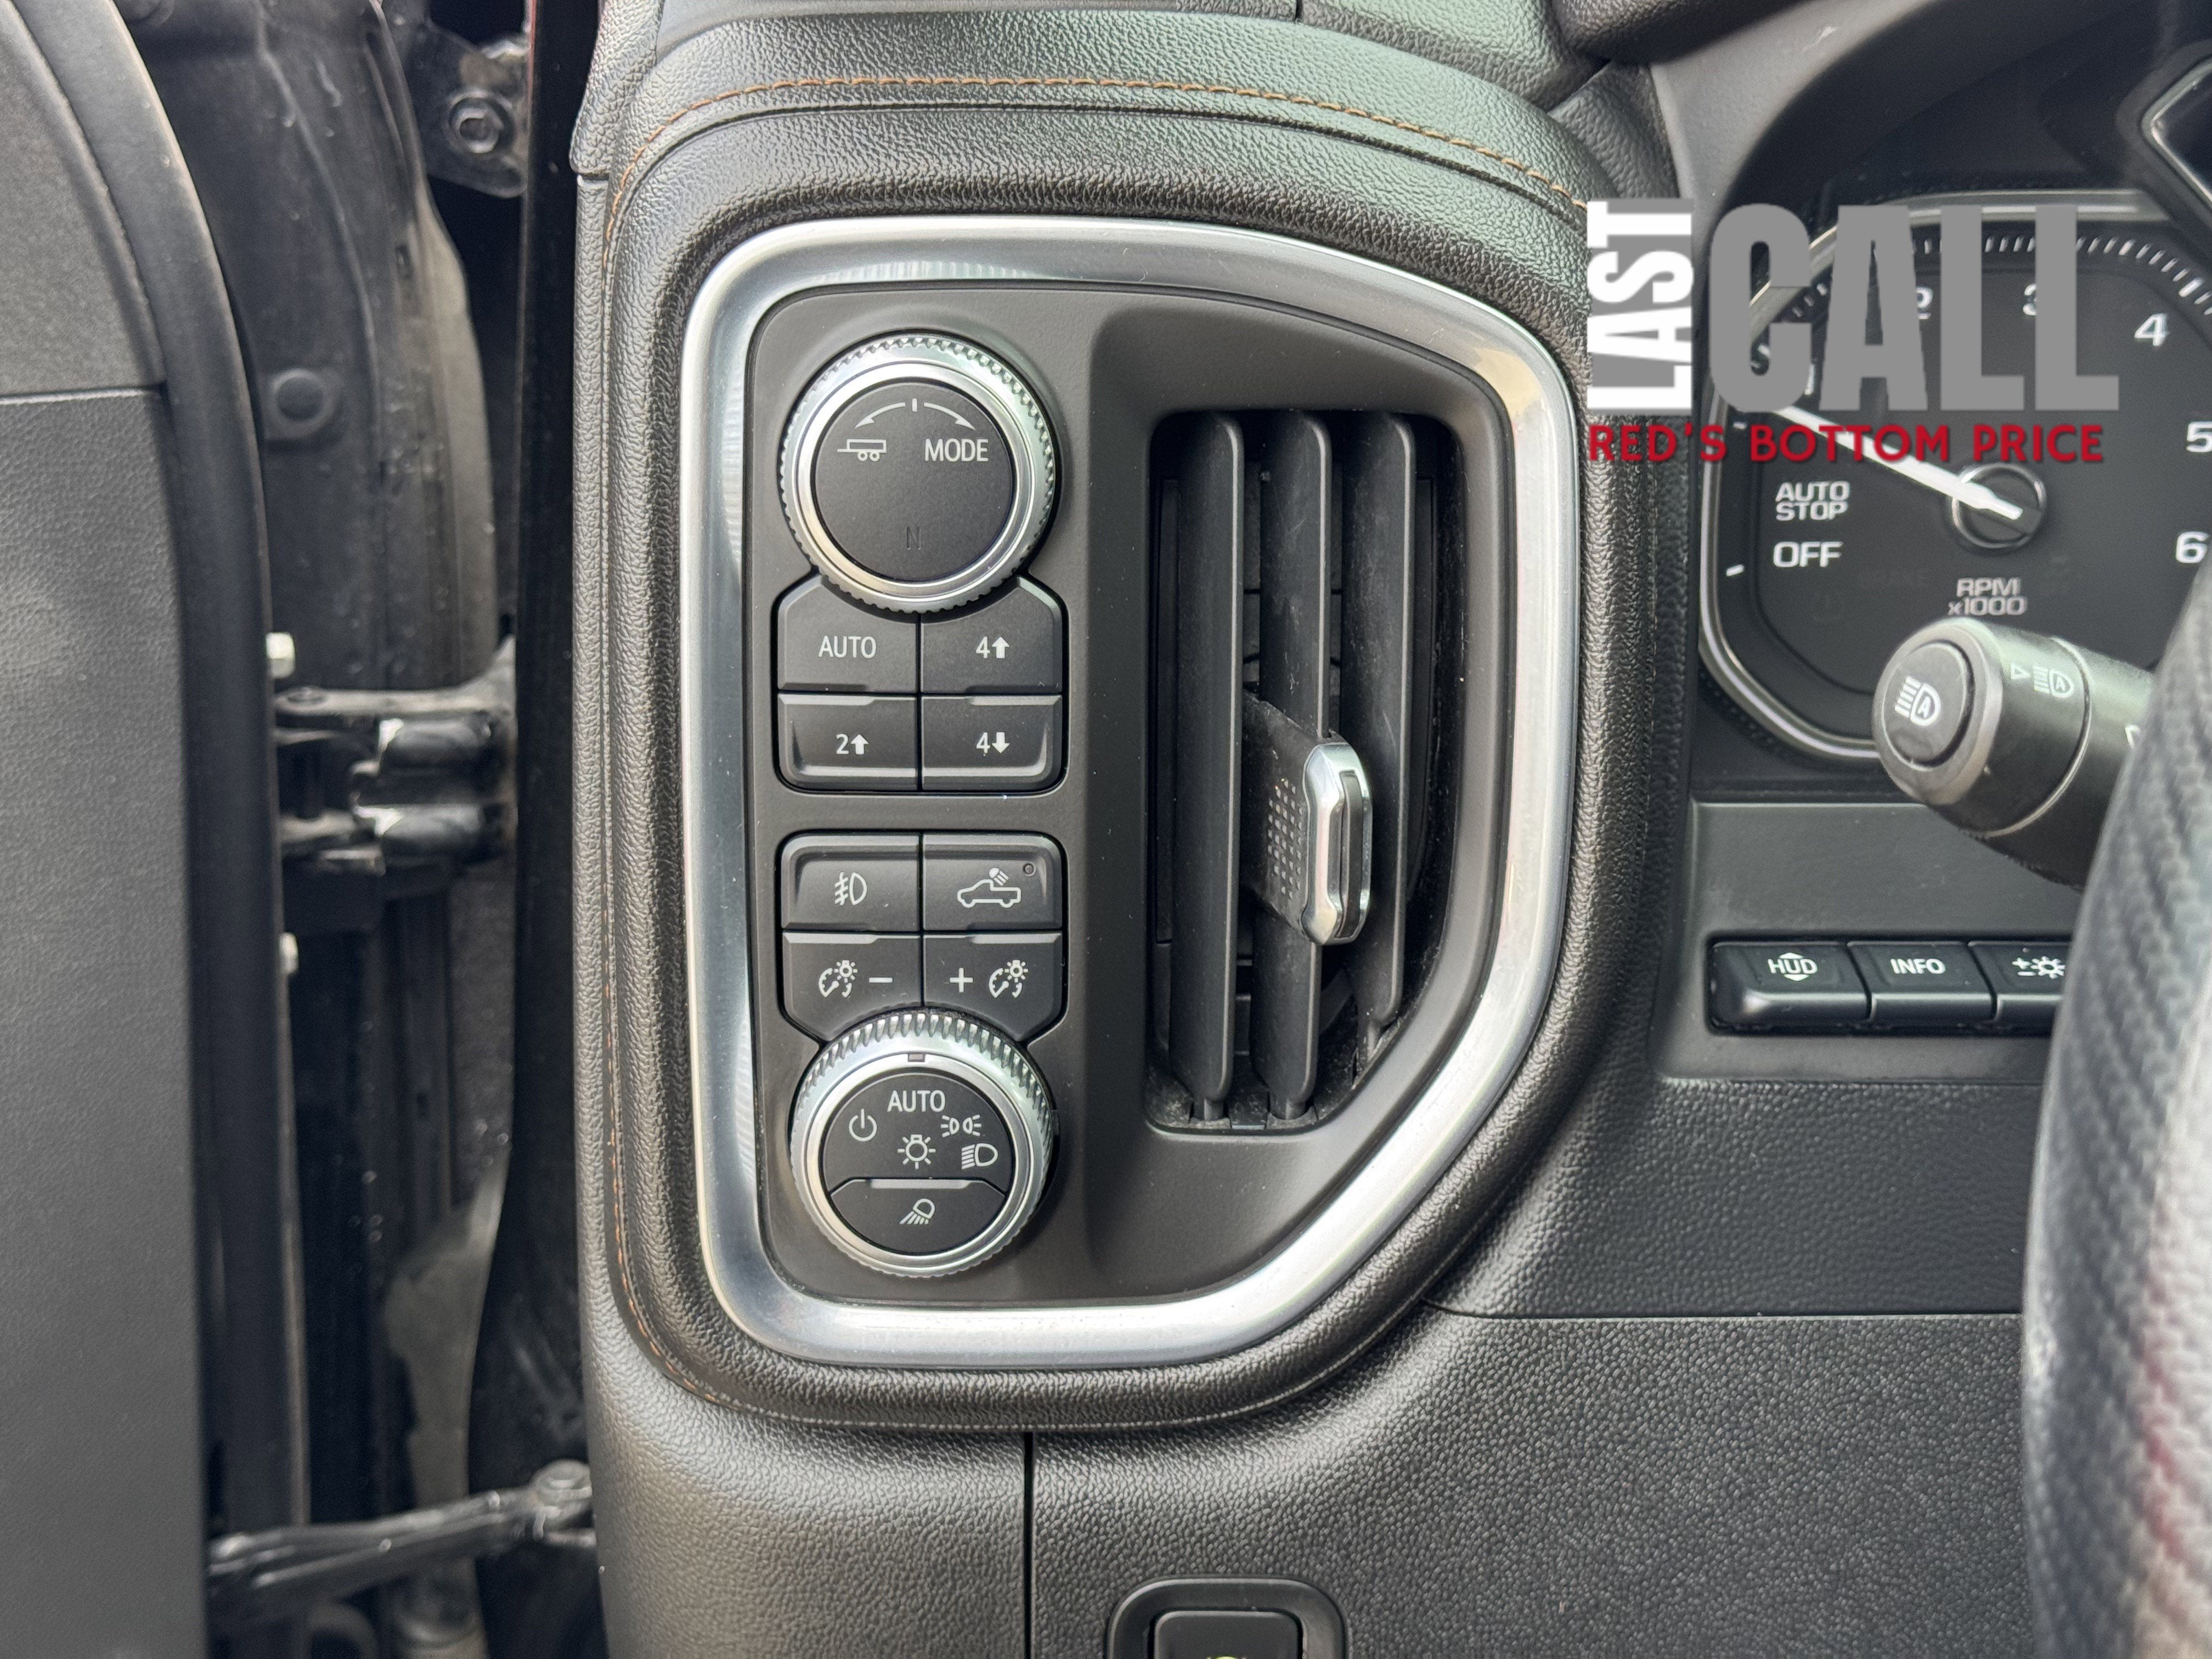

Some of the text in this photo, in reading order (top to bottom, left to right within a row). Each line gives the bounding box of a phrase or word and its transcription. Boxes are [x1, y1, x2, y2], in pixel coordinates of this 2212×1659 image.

[2134, 313, 2169, 347] 4
[2186, 421, 2212, 453] 5
[924, 438, 989, 462] MODE
[1775, 481, 1851, 501] AUTO
[1775, 501, 1848, 521] STOP
[1773, 541, 1843, 568] OFF
[2175, 531, 2209, 563] 6
[1956, 577, 2022, 597] RPM
[1948, 597, 2028, 616] x1000
[818, 635, 877, 658] AUTO
[975, 636, 990, 659] 4
[836, 733, 849, 755] 2
[975, 732, 990, 754] 4
[1767, 958, 1818, 975] HUD
[1890, 958, 1946, 974] INFO
[887, 1090, 946, 1112] AUTO
